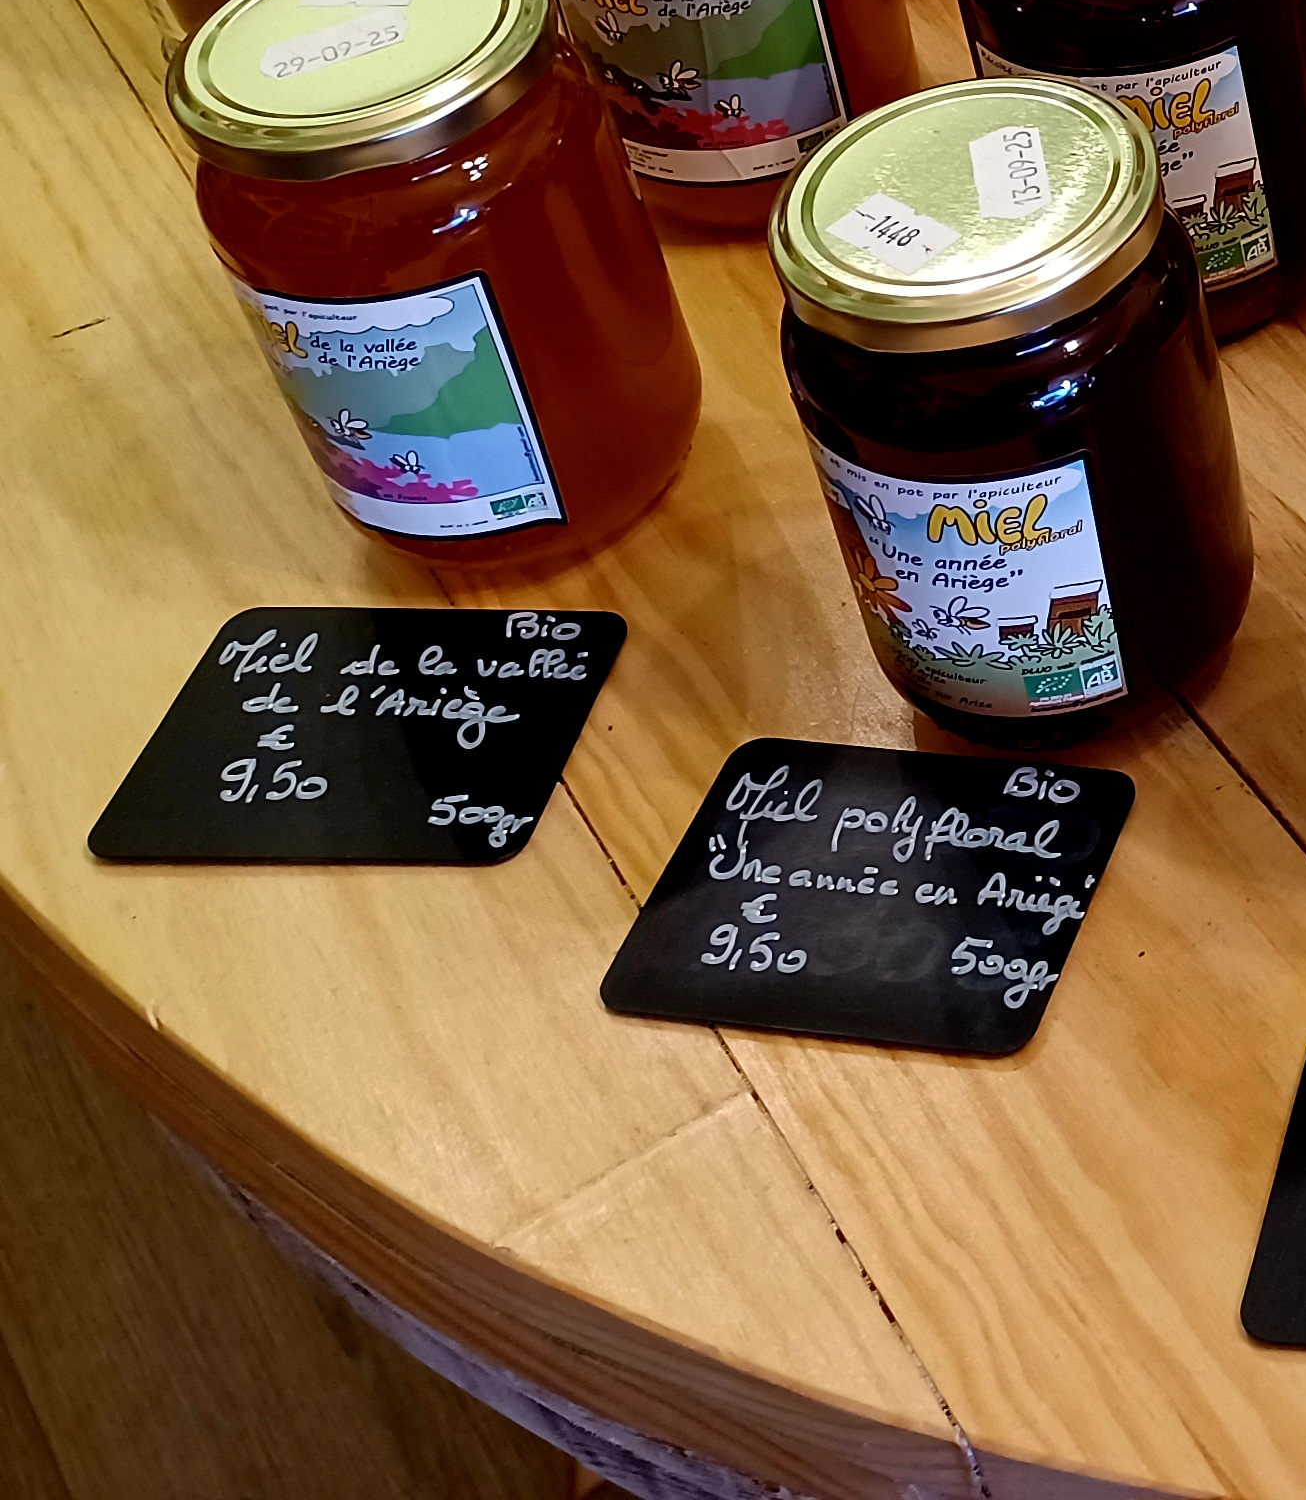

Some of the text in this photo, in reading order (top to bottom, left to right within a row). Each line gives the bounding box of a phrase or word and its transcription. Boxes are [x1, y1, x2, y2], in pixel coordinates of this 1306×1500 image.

[658, 0, 751, 17] de l'Ariège
[274, 25, 400, 79] 29-09-25
[1145, 61, 1222, 89] l'apiculteur
[1003, 131, 1042, 206] 13-09-25
[868, 215, 921, 247] 1448
[310, 336, 418, 354] de la vallée
[318, 352, 421, 371] de l'Ariège
[874, 475, 1062, 500] en pot par l'apiculteur
[999, 520, 1083, 557] polyfloral
[895, 568, 919, 583] en
[934, 555, 1007, 572] année
[505, 612, 581, 640] Bio
[218, 629, 588, 681] Miel de la vallée
[1085, 665, 1114, 690] AB
[242, 683, 520, 750] de l'Ariège
[257, 724, 294, 750] €
[219, 758, 328, 803] 9,50
[1003, 768, 1080, 803] Bio
[726, 764, 1061, 863] Miel polyfloral
[788, 866, 899, 898] année
[915, 883, 957, 905] en
[741, 894, 777, 924] €
[701, 924, 807, 973] 9,50
[951, 937, 1058, 1009] 500gr
